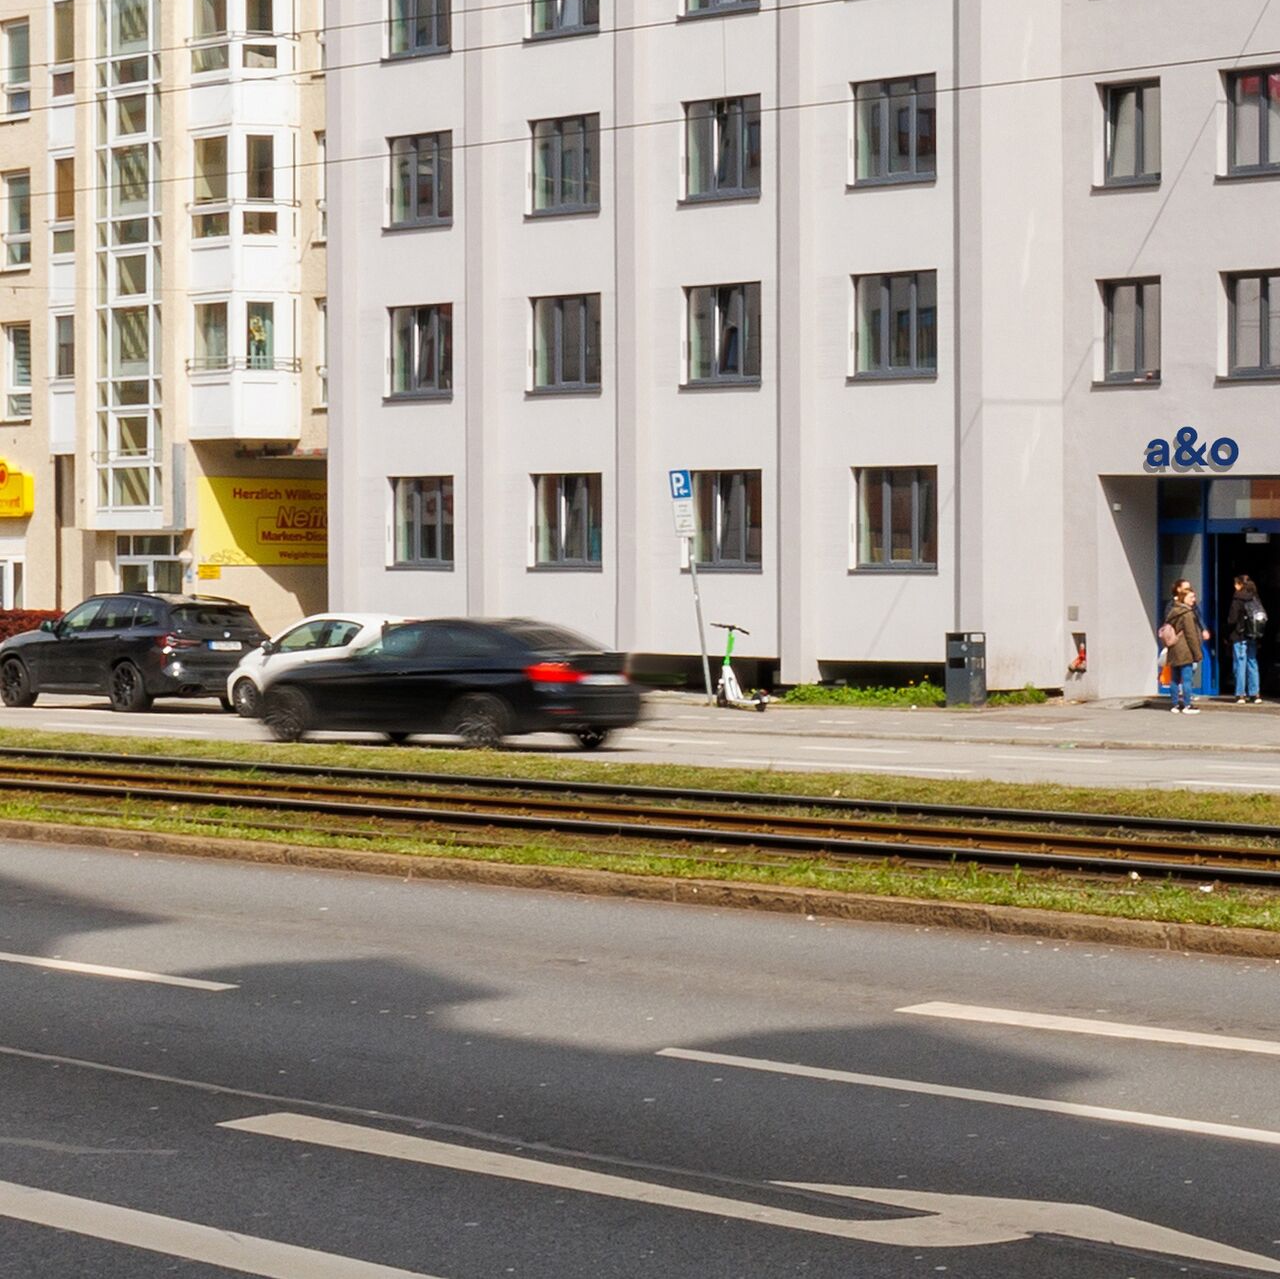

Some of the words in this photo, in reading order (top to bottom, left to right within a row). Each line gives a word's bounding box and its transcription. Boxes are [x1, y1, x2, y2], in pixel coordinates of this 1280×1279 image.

[1146, 426, 1240, 467] a&o
[233, 488, 282, 500] Herzlich
[671, 472, 685, 497] P
